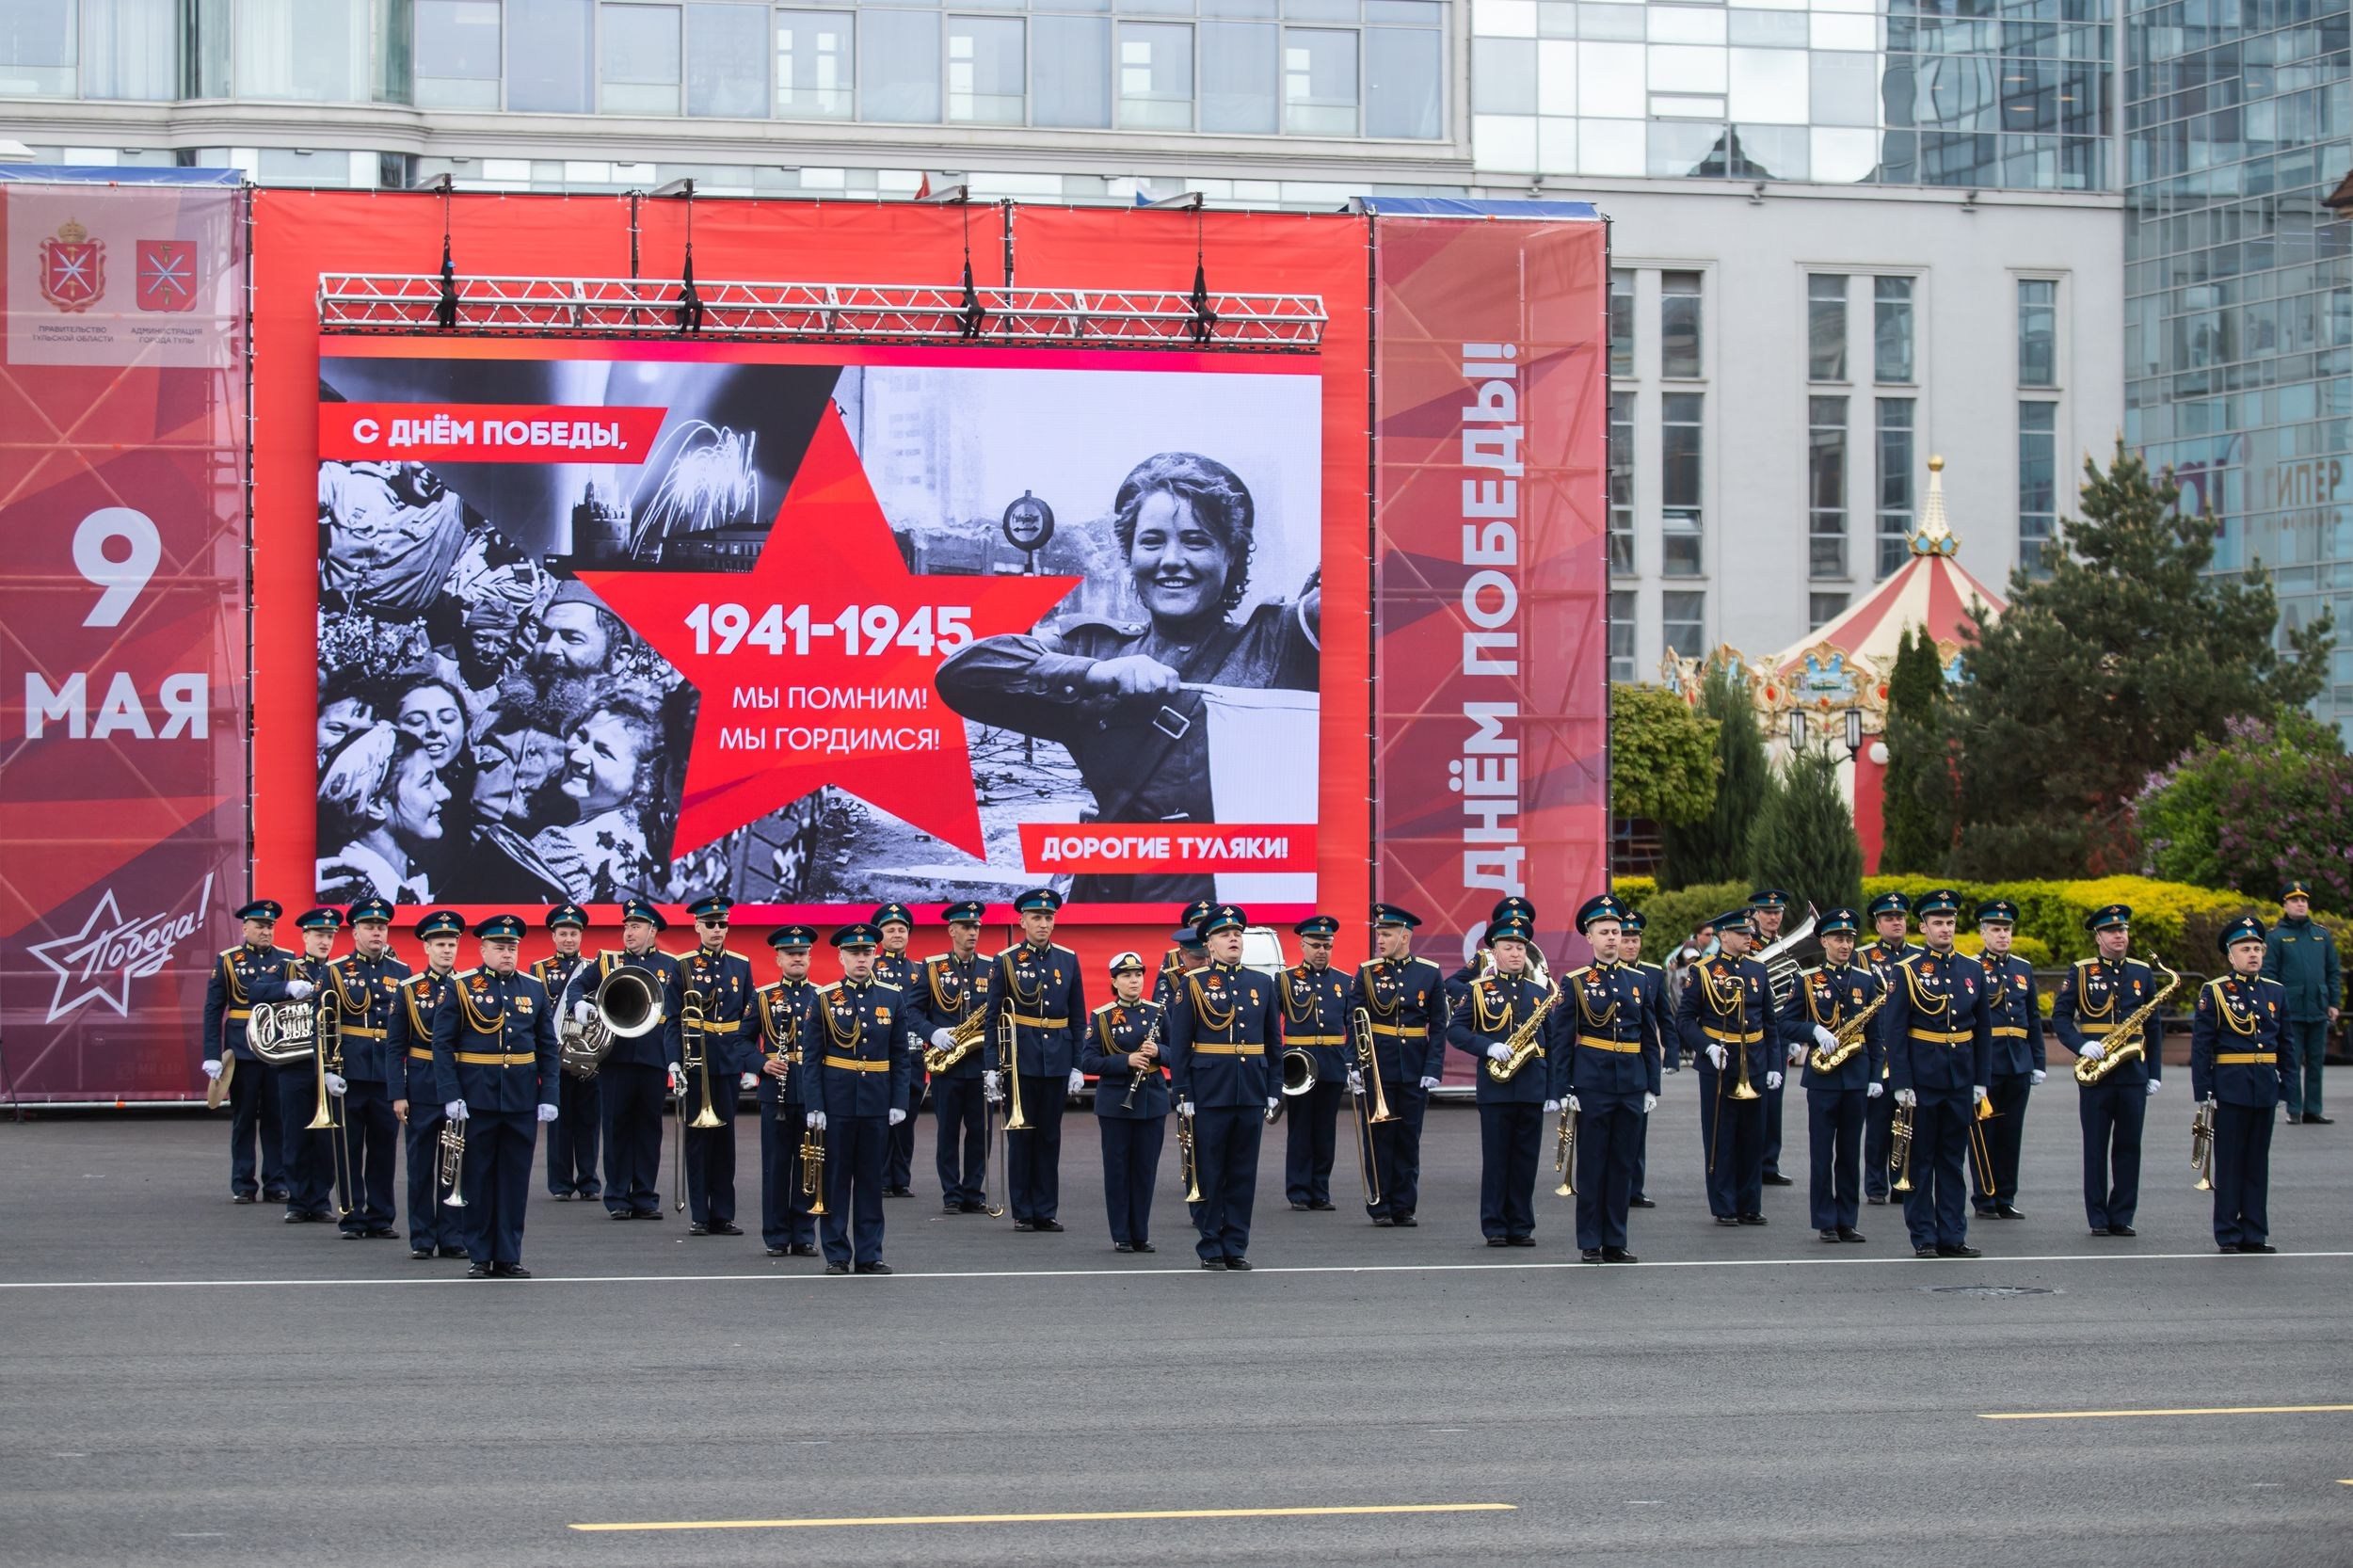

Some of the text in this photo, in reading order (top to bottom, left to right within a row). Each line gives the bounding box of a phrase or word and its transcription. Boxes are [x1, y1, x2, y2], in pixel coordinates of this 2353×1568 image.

[39, 326, 106, 334] ПРАВИТЕЛЬСТВО
[353, 413, 628, 450] С ДНЁМ ПОБЕДЫ,
[1462, 343, 1525, 676] ПОБЕДЫ!
[72, 506, 162, 627] 9
[683, 602, 974, 657] 1941-1945
[24, 671, 209, 739] МАЯ
[732, 686, 927, 710] МЫ ПОМНИМ!
[719, 728, 939, 755] МЫ ГОРДИМСЯ!
[1041, 837, 1289, 861] ДОРОГИЕ ТУЛЯКИ!
[63, 872, 215, 984] Победа!
